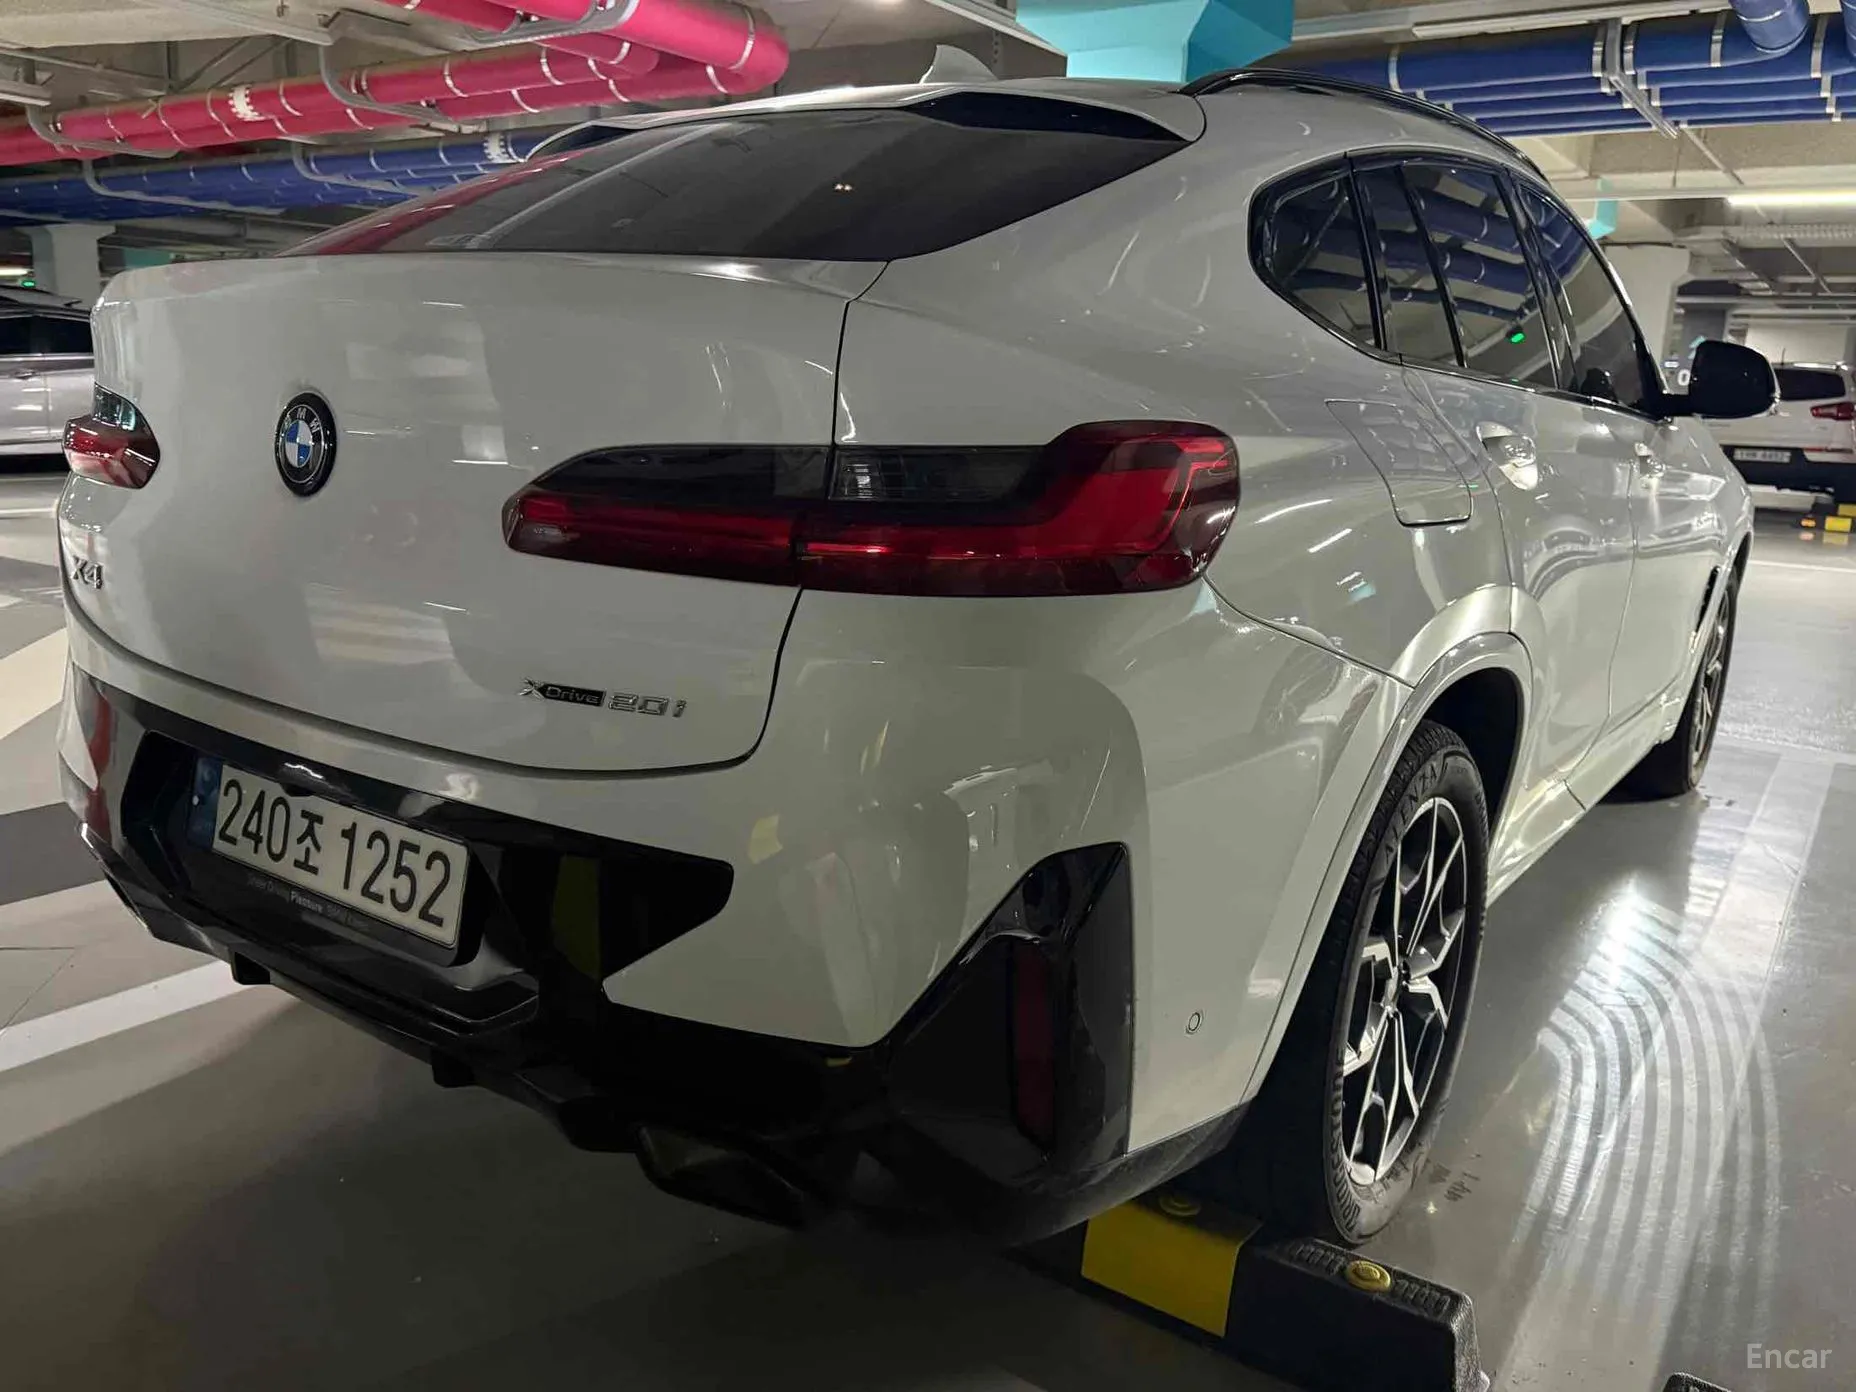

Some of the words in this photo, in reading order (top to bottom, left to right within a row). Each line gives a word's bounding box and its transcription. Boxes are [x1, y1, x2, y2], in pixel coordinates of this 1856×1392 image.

[71, 555, 104, 590] X4
[608, 692, 687, 718] 20i
[218, 778, 324, 876] 240조
[340, 821, 451, 928] 1252
